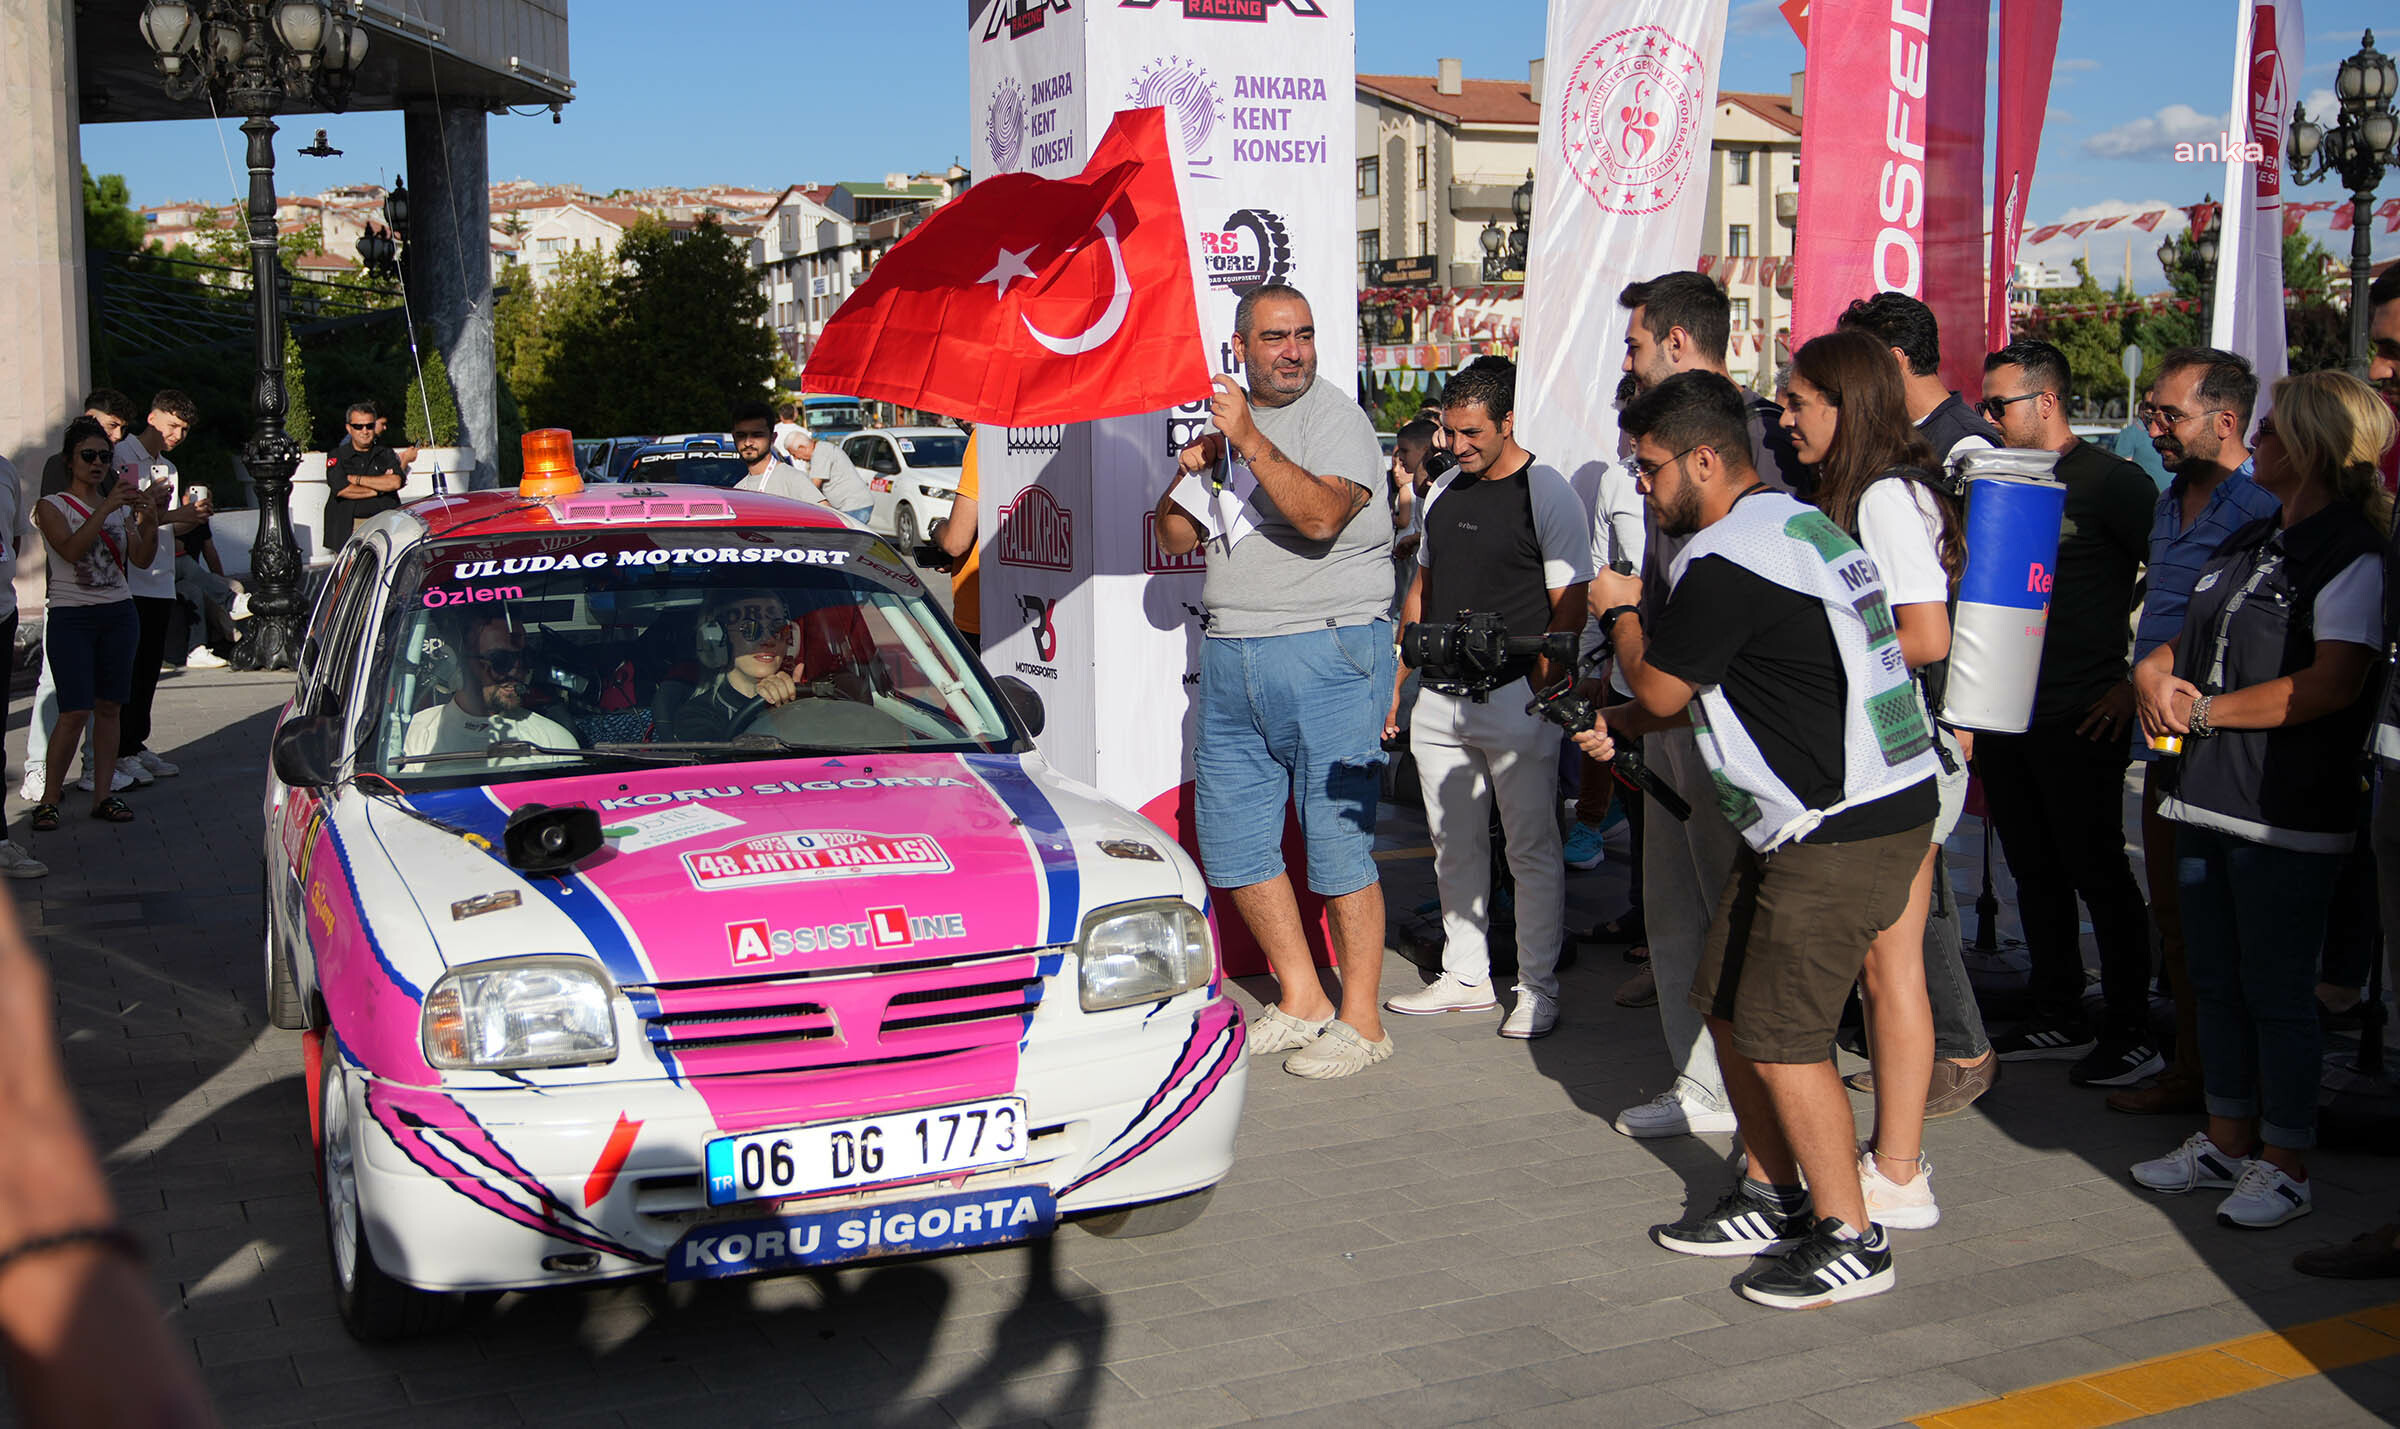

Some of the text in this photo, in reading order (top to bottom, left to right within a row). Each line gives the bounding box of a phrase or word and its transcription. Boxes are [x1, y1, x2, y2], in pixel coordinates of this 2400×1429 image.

[1012, 8, 1043, 32] RACING
[1188, 0, 1262, 16] RACING
[1031, 72, 1073, 107] ANKARA
[1234, 76, 1326, 101] ANKARA
[1233, 108, 1290, 130] KENT
[1677, 92, 1689, 124] SPOR
[1031, 108, 1056, 138] KENT
[1031, 129, 1073, 169] KONSEYİ
[1233, 136, 1326, 163] KONSEYİ
[453, 547, 851, 580] ULUDAG MOTORSPORT
[422, 586, 523, 609] Özlem
[1015, 661, 1058, 680] MOTORSPORTS
[599, 775, 975, 811] KORU SİGORTA
[822, 834, 868, 847] 2024
[828, 838, 938, 861] RALLİSİ
[742, 1107, 1017, 1191] 06 DG 1773
[713, 1175, 734, 1191] TR
[685, 1196, 1040, 1268] KORU SİGORTA
